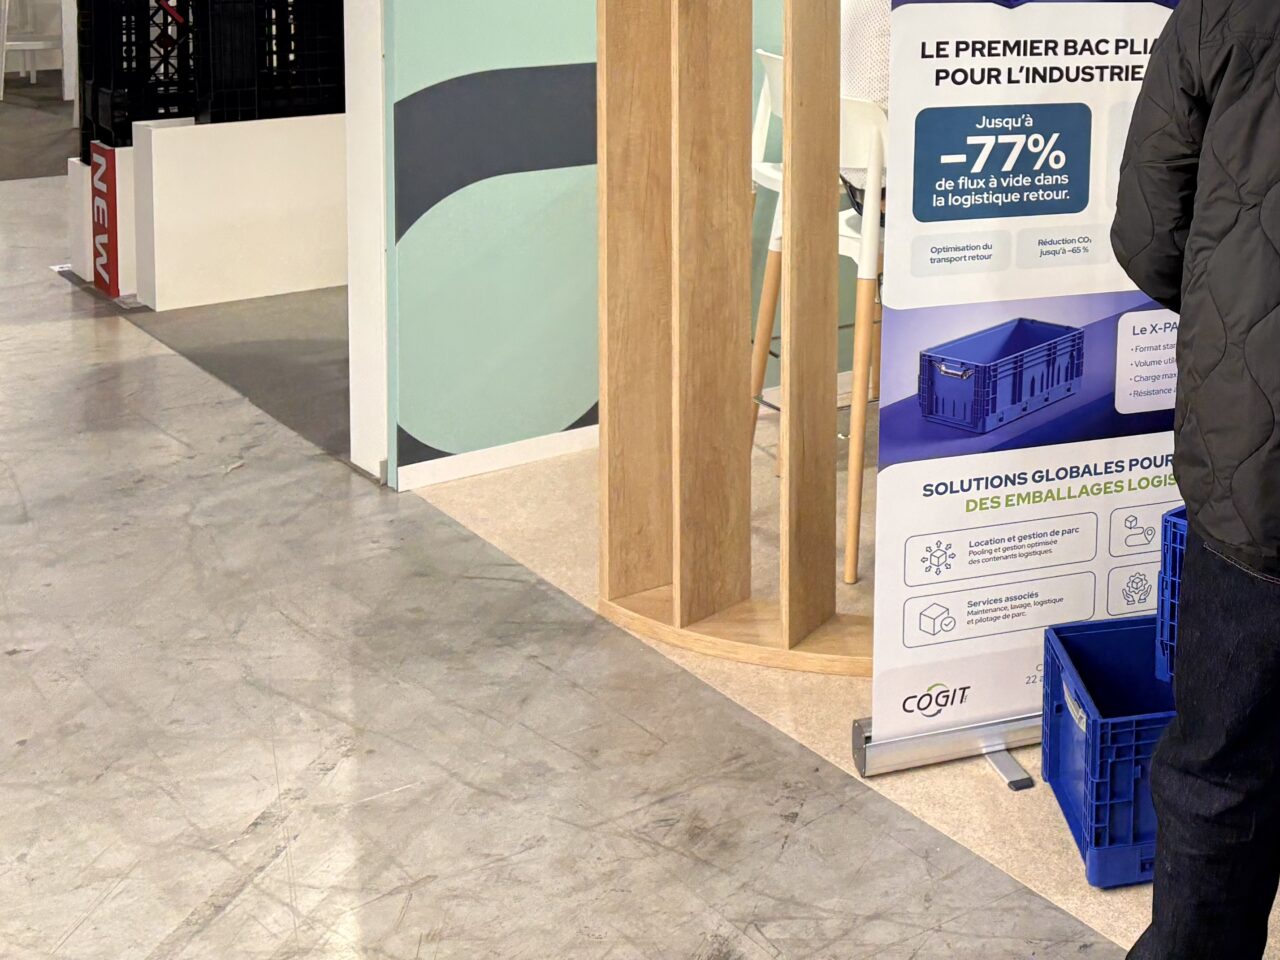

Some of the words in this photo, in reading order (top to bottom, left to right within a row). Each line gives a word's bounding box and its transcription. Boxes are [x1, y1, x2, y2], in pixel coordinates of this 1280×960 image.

[920, 41, 949, 59] LE
[955, 39, 1058, 58] PREMIER
[1064, 38, 1109, 56] BAC
[935, 67, 1001, 86] POUR
[1007, 64, 1144, 84] L'INDUSTRIE
[976, 113, 1033, 130] Jusqu'à
[935, 177, 955, 191] de
[958, 175, 986, 190] flux
[989, 174, 998, 189] à
[1001, 174, 1032, 188] vide
[1035, 172, 1069, 186] dans
[932, 193, 945, 207] la
[948, 190, 1021, 209] logistique
[1023, 188, 1070, 203] retour.
[92, 152, 111, 285] NEW
[930, 243, 981, 255] Optimisation
[982, 242, 993, 251] du
[1038, 237, 1077, 247] Réduction
[930, 254, 967, 265] transport
[968, 253, 993, 262] retour
[1132, 325, 1148, 336] Le
[1134, 344, 1162, 353] Format
[1134, 359, 1162, 368] Volume
[1133, 374, 1161, 383] Charge
[1132, 388, 1172, 398] Résistance
[922, 472, 1028, 498] SOLUTIONS
[1032, 460, 1125, 484] GLOBALES
[1128, 453, 1174, 472] POUR
[965, 496, 1001, 513] DES
[1005, 482, 1125, 508] EMBALLAGES
[1127, 473, 1177, 491] LOGIS
[968, 537, 1006, 548] Location
[1007, 535, 1017, 543] et
[1017, 531, 1048, 543] gestion
[1049, 529, 1060, 537] de
[1061, 527, 1080, 537] parc
[968, 547, 993, 557] Pooling
[993, 546, 1001, 554] et
[1001, 543, 1026, 554] gestion
[1027, 539, 1058, 549] optimisée
[981, 553, 1017, 563] contenants
[966, 606, 1009, 617] Maintenance,
[1033, 597, 1064, 607] logistique
[967, 597, 1003, 609] Services
[1004, 591, 1039, 603] associés
[966, 618, 974, 626] et
[974, 614, 1001, 626] pilotage
[1025, 674, 1037, 685] 22
[902, 686, 971, 714] COGIT
